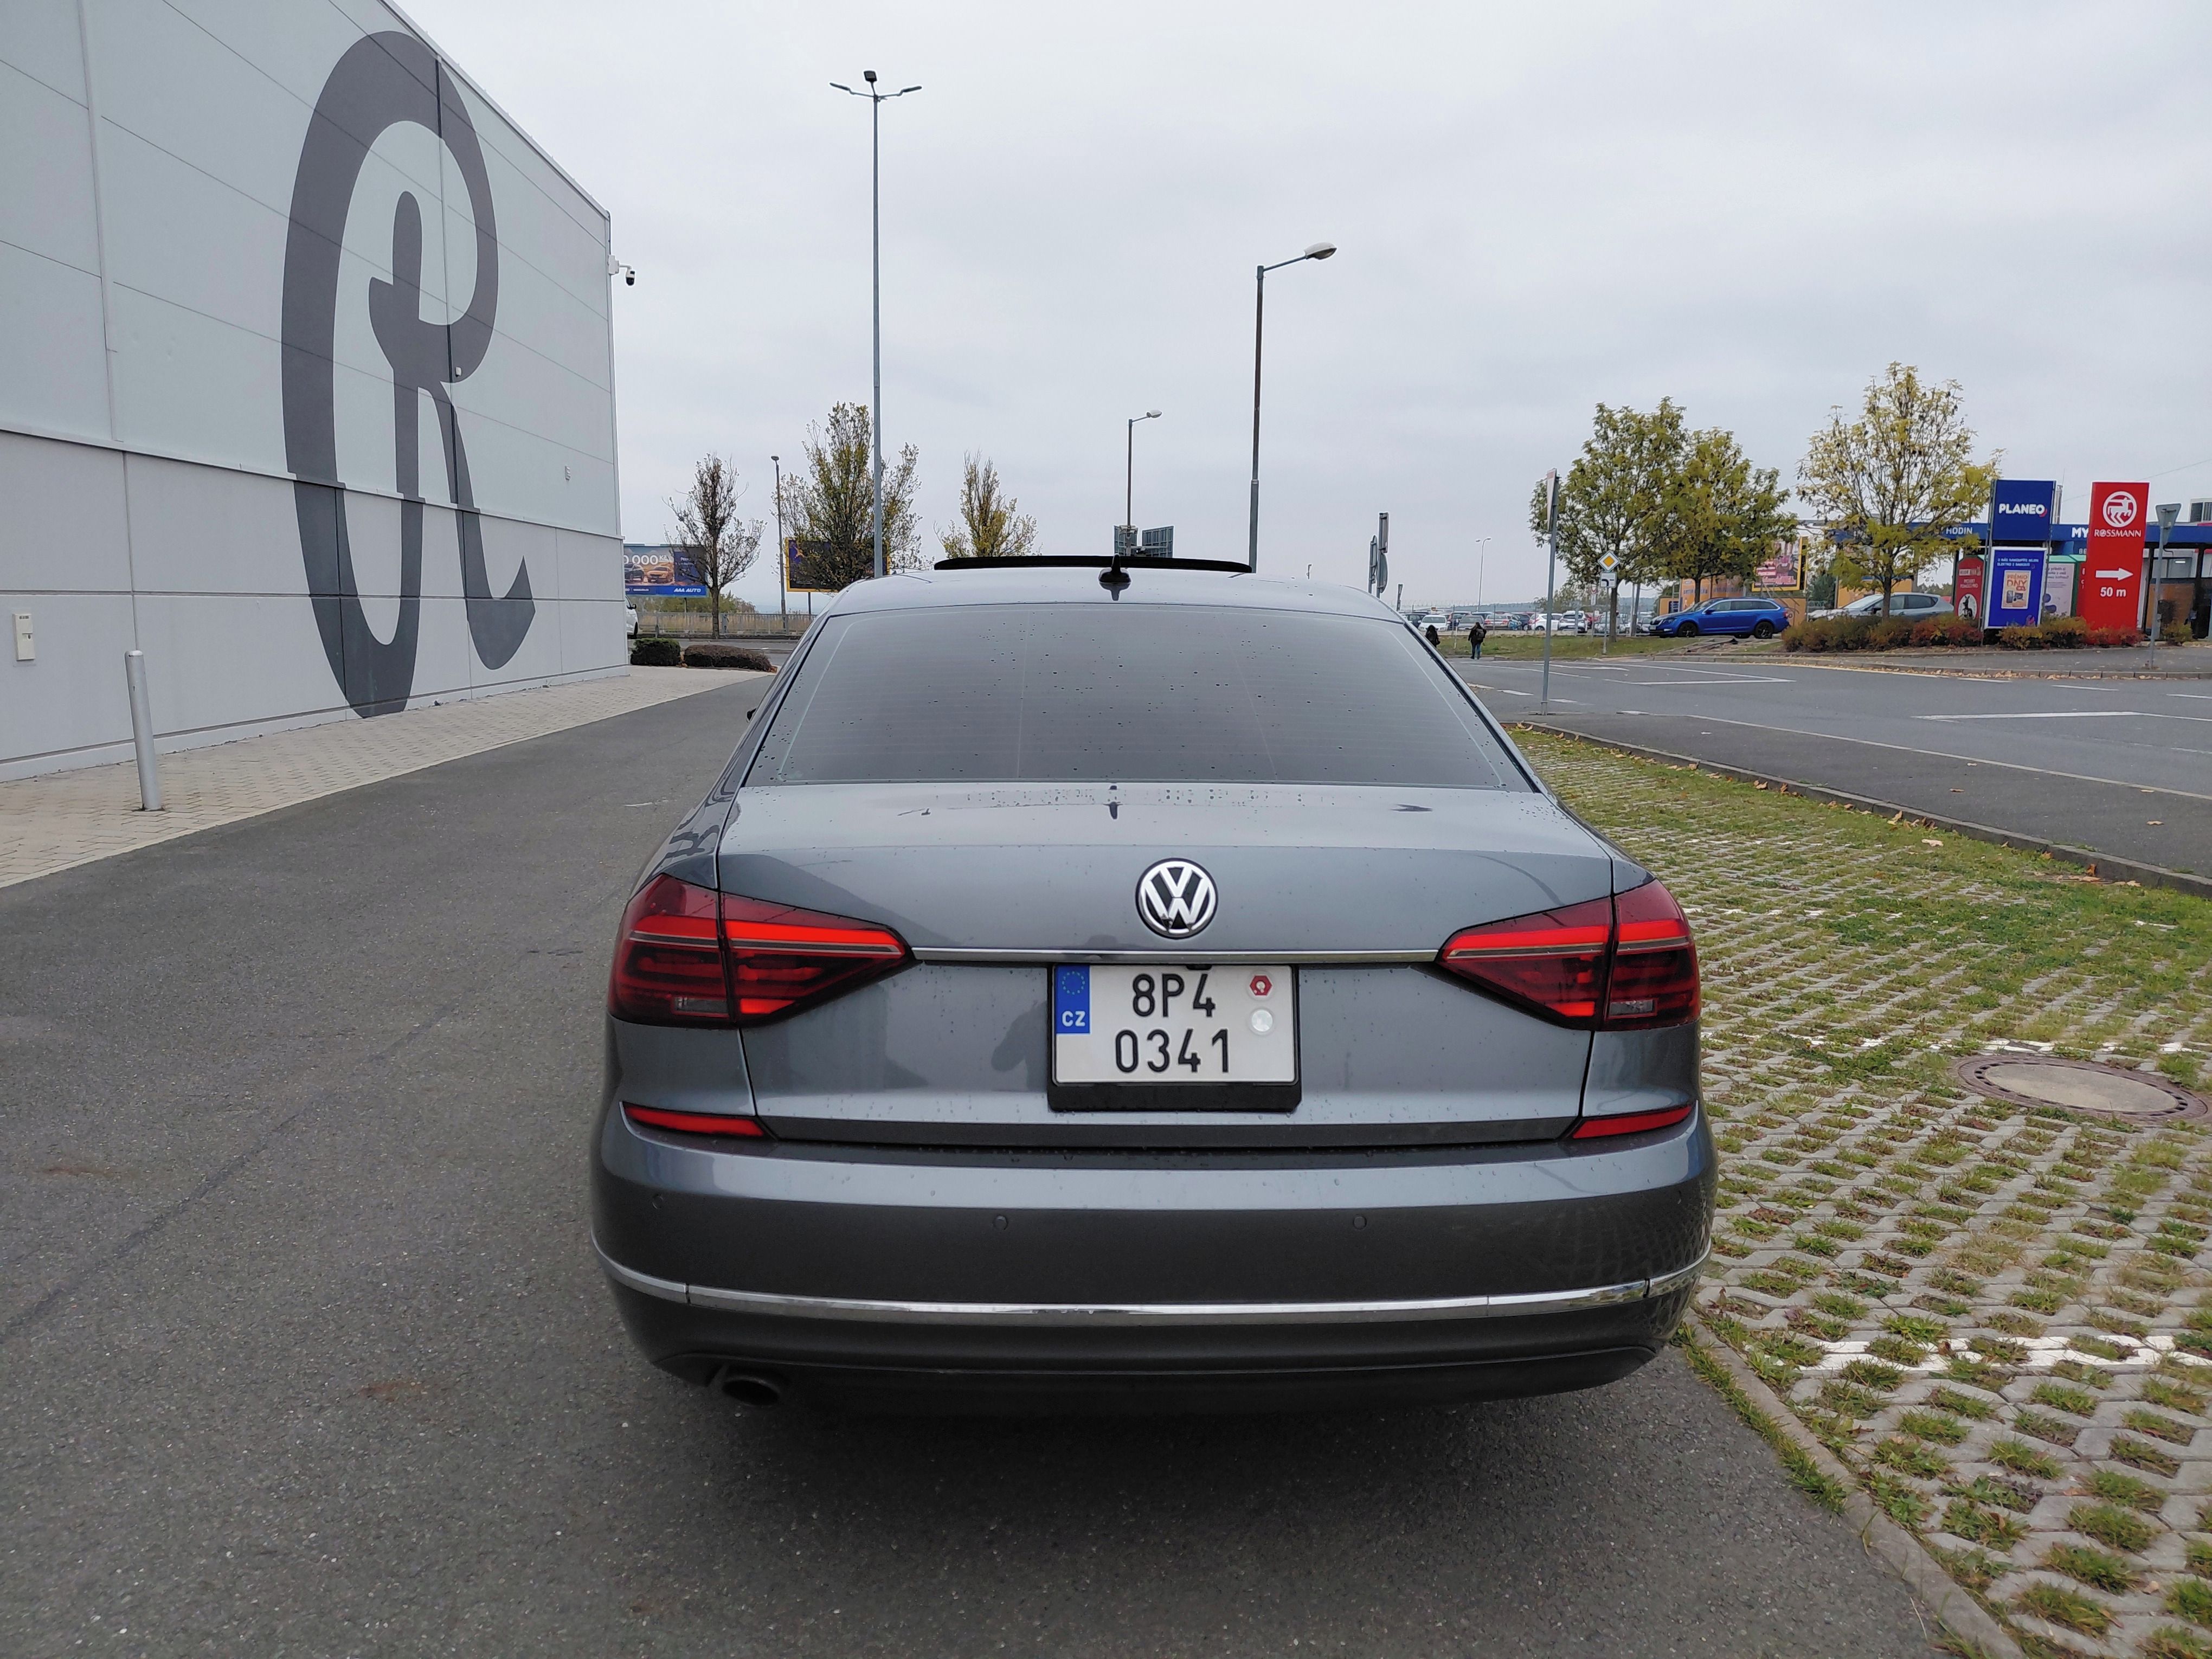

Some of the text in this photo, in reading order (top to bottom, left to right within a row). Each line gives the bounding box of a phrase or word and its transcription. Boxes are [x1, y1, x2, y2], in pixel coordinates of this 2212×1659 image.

[1999, 503, 2045, 515] PLANEO
[1946, 526, 1972, 535] HODIN
[2094, 529, 2142, 537] ROSSMANN
[632, 555, 658, 565] 000
[2100, 587, 2126, 597] 50 m
[1133, 974, 1216, 1018] 8P4
[1062, 1011, 1086, 1027] CZ
[1115, 1028, 1229, 1073] 0341
